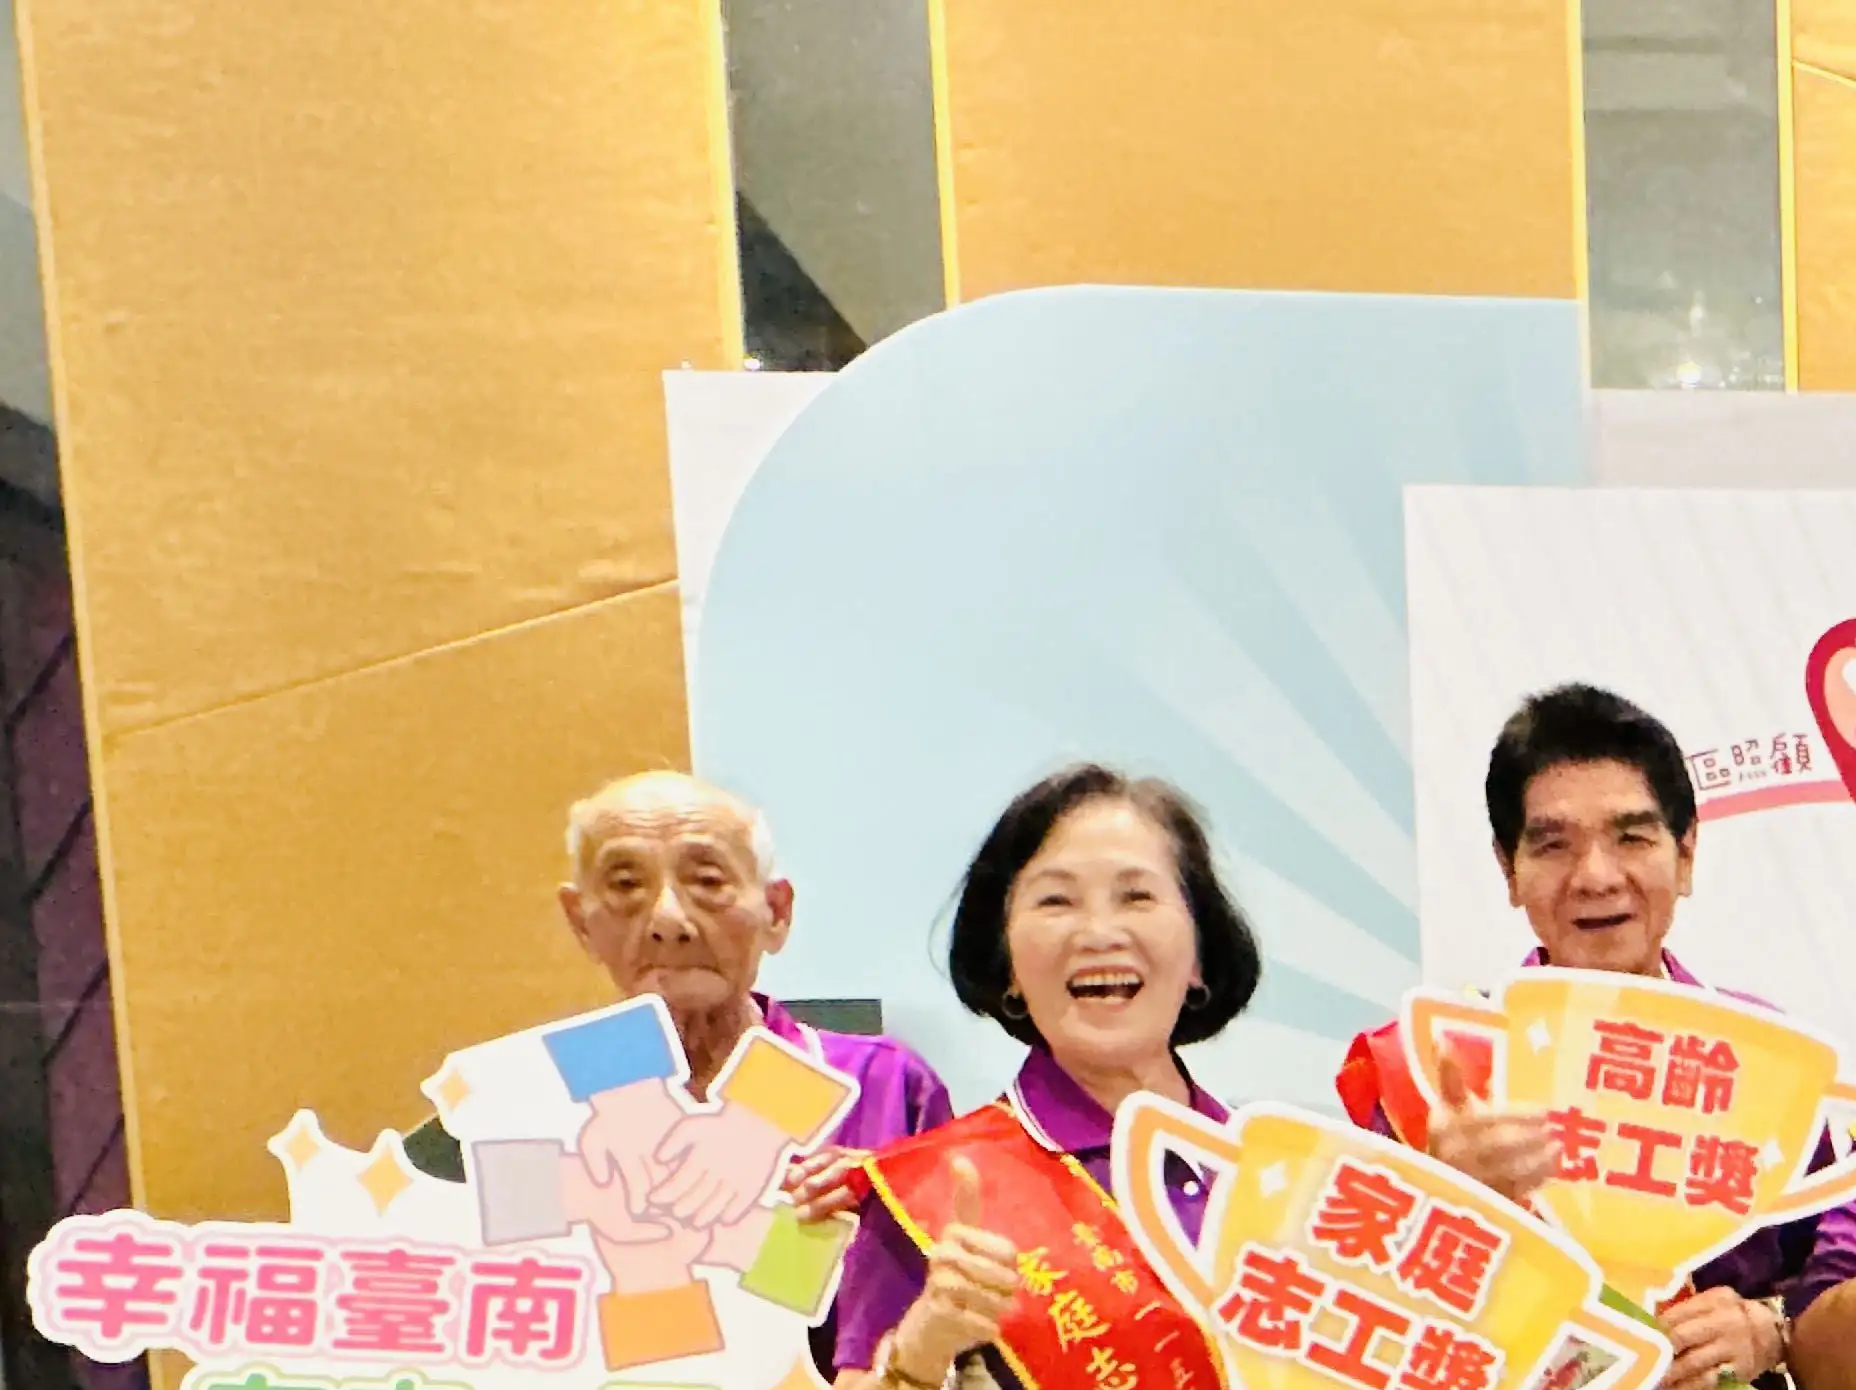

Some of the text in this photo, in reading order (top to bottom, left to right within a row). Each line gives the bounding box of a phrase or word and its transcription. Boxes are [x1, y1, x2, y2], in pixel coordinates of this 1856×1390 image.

[1583, 1018, 1740, 1115] 高齡
[1545, 1105, 1758, 1216] 志工獎
[55, 1230, 584, 1362] 幸福臺南
[1311, 1163, 1505, 1316] 家庭
